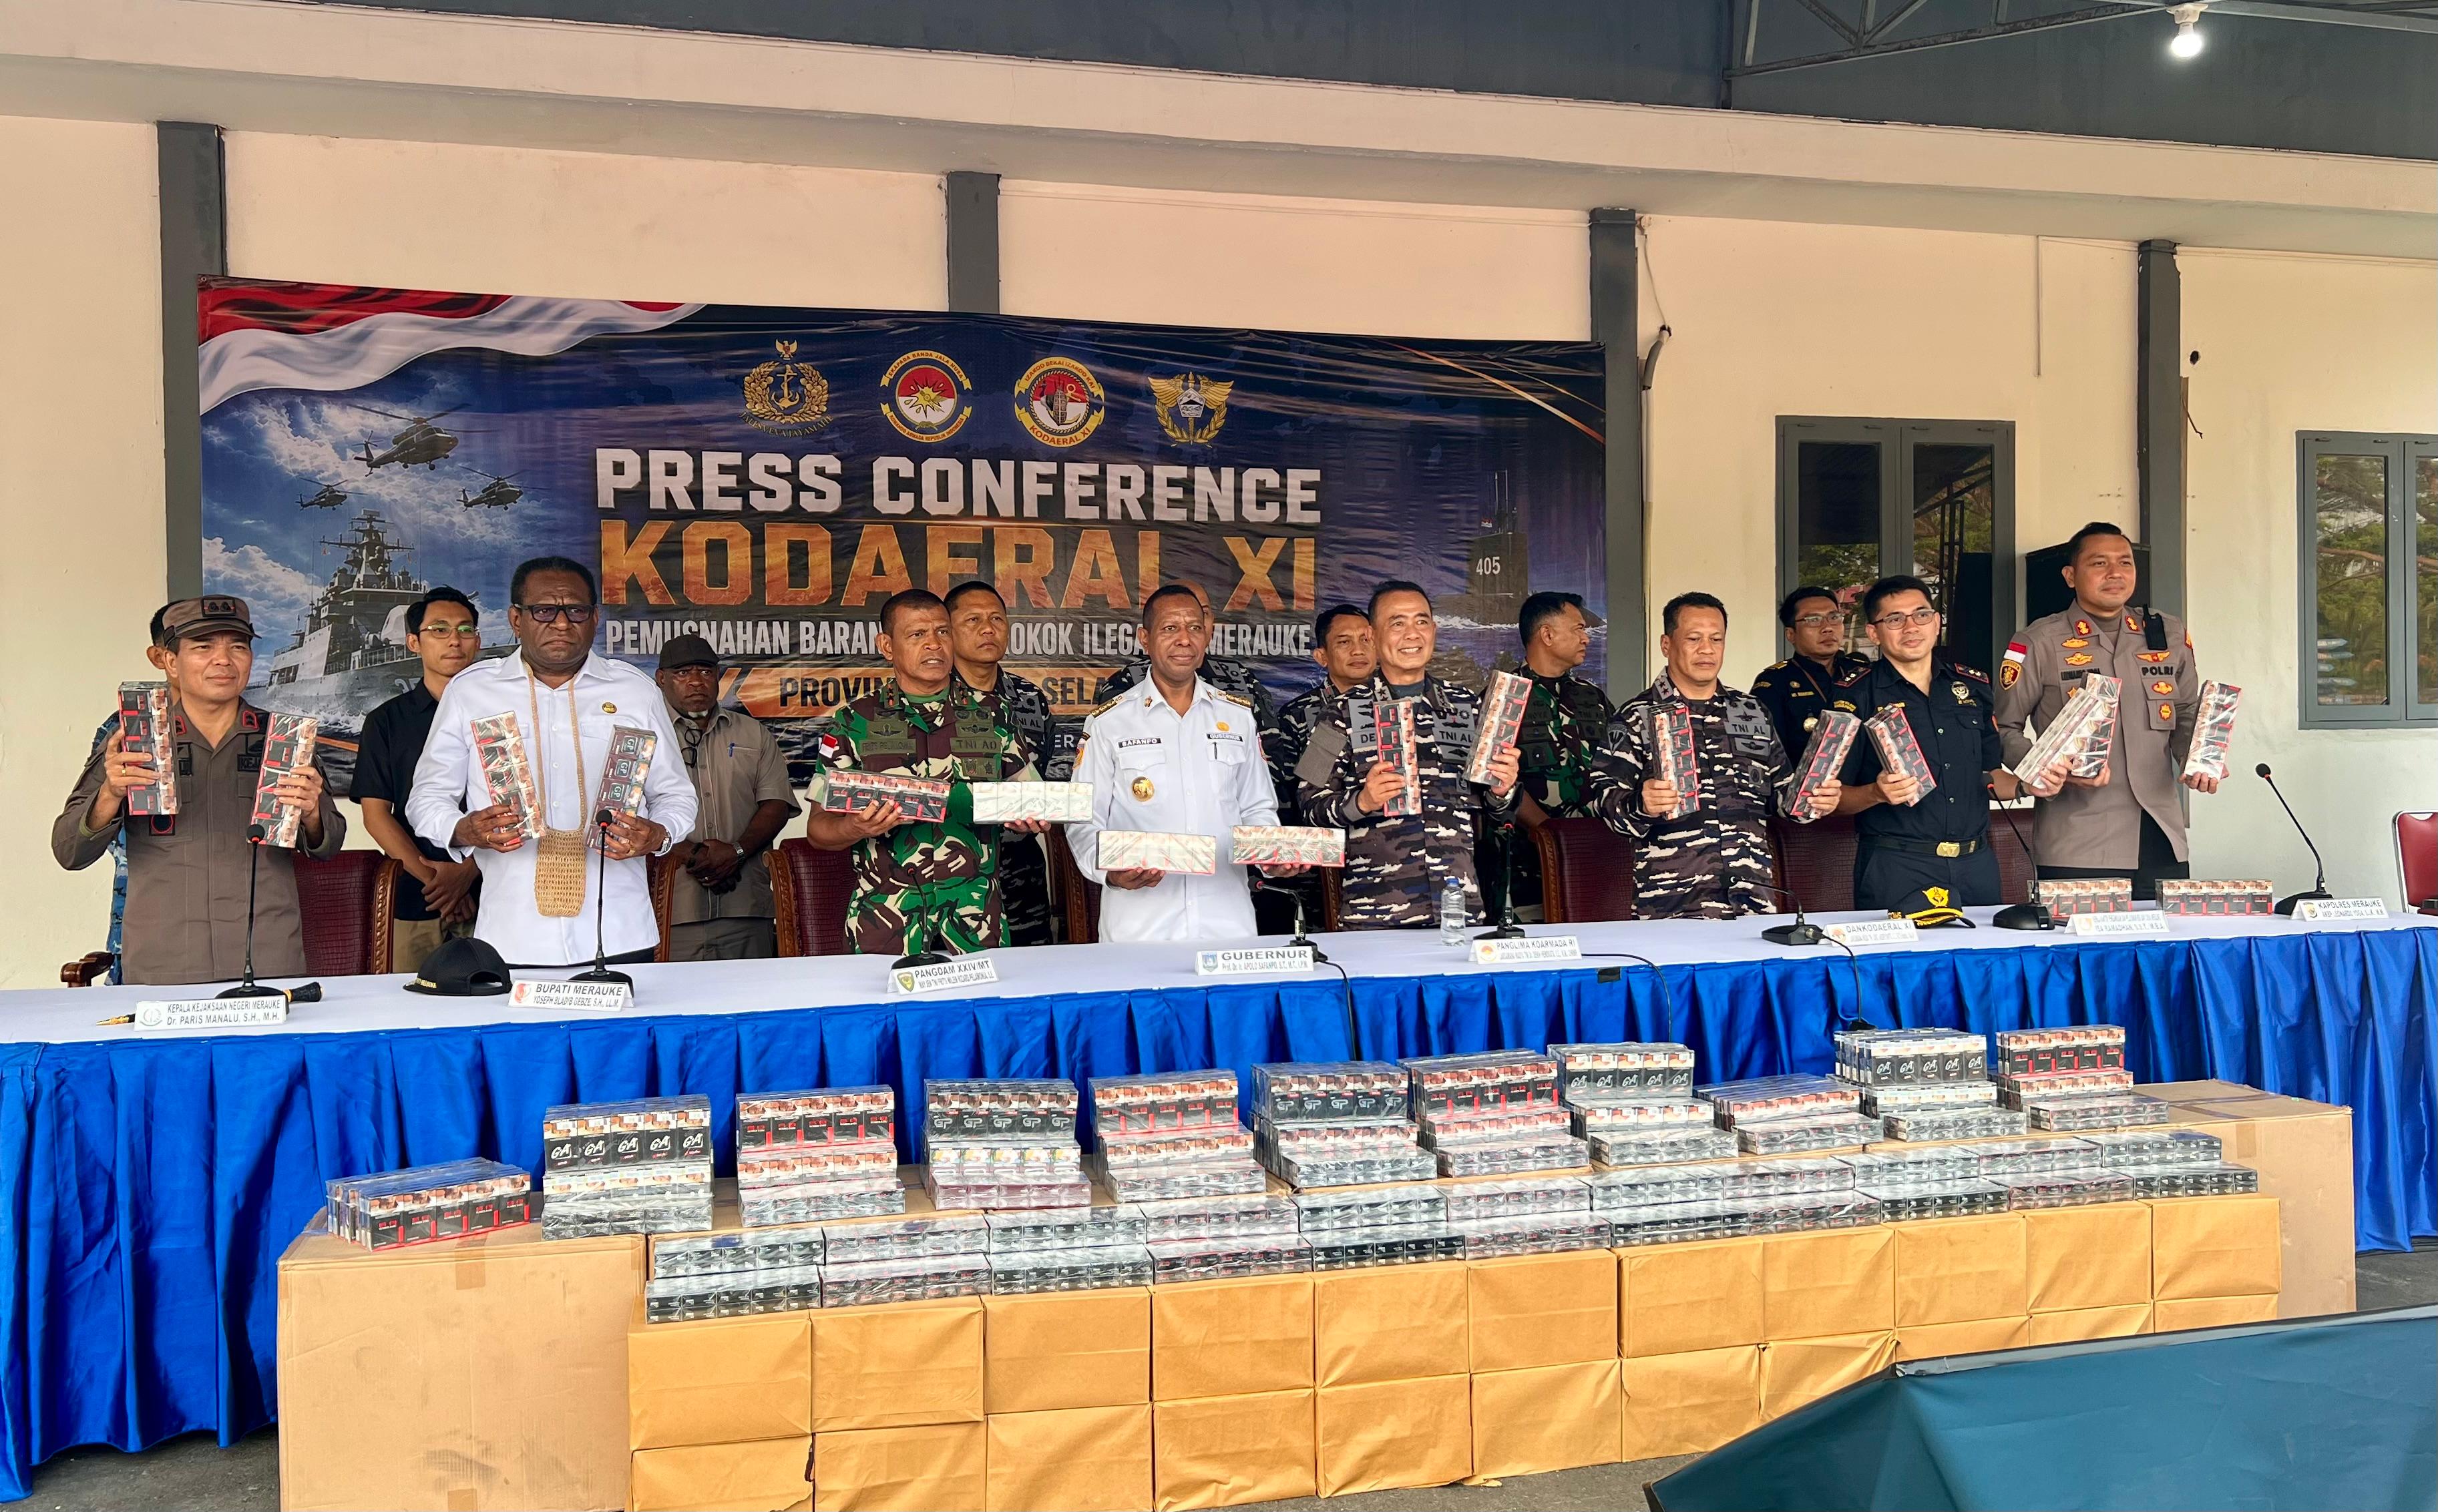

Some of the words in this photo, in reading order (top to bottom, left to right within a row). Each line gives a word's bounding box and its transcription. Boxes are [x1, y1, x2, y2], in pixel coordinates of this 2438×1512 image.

[1029, 425, 1082, 445] KODAERAL
[1080, 426, 1092, 438] XI
[596, 448, 841, 513] PRESS
[873, 456, 1321, 523] CONFERENCE
[1476, 556, 1501, 575] 405
[1222, 536, 1315, 612] XI
[999, 622, 1074, 656] OKOK
[2142, 665, 2174, 677] POLRI
[1030, 719, 1042, 728] AL
[1732, 723, 1750, 733] TNI
[1754, 724, 1766, 735] AL
[1122, 738, 1158, 748] SAFANPO
[1439, 730, 1457, 741] TNI
[1460, 733, 1472, 743] AL
[626, 738, 636, 751] GP
[956, 739, 976, 750] TNI
[620, 761, 629, 774] GP
[613, 785, 622, 798] GP
[2318, 901, 2351, 909] KAPOLRES
[2351, 899, 2382, 908] MERAUKE
[1846, 923, 1902, 933] DANKODAERAL
[1496, 941, 1531, 950] PANGLIMA
[1532, 939, 1567, 949] KOARMADA
[1569, 939, 1576, 947] RI
[1221, 950, 1308, 961] GUBERNUR
[915, 965, 956, 979] PANGDAM
[536, 983, 571, 994] BUPATI
[573, 985, 623, 997] MERAUKE
[168, 1003, 190, 1013] KEPALA
[192, 1002, 227, 1012] KEJAKSAAN
[229, 1001, 250, 1010] NEGERI
[252, 999, 280, 1009] MERAUKE
[534, 995, 554, 1005] YOSEPH
[167, 1016, 177, 1025] Dr.
[180, 1015, 203, 1025] PARIS
[1876, 1061, 1892, 1075] GA
[1900, 1060, 1914, 1073] GA
[1923, 1059, 1938, 1072] GA
[1945, 1058, 1960, 1071] GA
[1968, 1056, 1983, 1069] GA
[1571, 1075, 1587, 1088] GA
[1597, 1074, 1613, 1087] GA
[1622, 1074, 1639, 1087] GA
[1647, 1073, 1663, 1086] GA
[1672, 1073, 1689, 1085] GA
[1277, 1100, 1294, 1111] GP
[1304, 1099, 1322, 1110] GP
[1331, 1099, 1349, 1109] GP
[1358, 1098, 1376, 1108] GP
[1385, 1097, 1402, 1107] GP
[934, 1117, 953, 1129] GP
[964, 1117, 983, 1129] GP
[993, 1117, 1012, 1128] GP
[1022, 1117, 1042, 1128] GP
[1051, 1117, 1070, 1128] GP
[617, 1137, 638, 1154] GA
[650, 1135, 670, 1152] GA
[682, 1133, 704, 1149] GA
[551, 1144, 572, 1160] GA
[584, 1140, 605, 1157] GA
